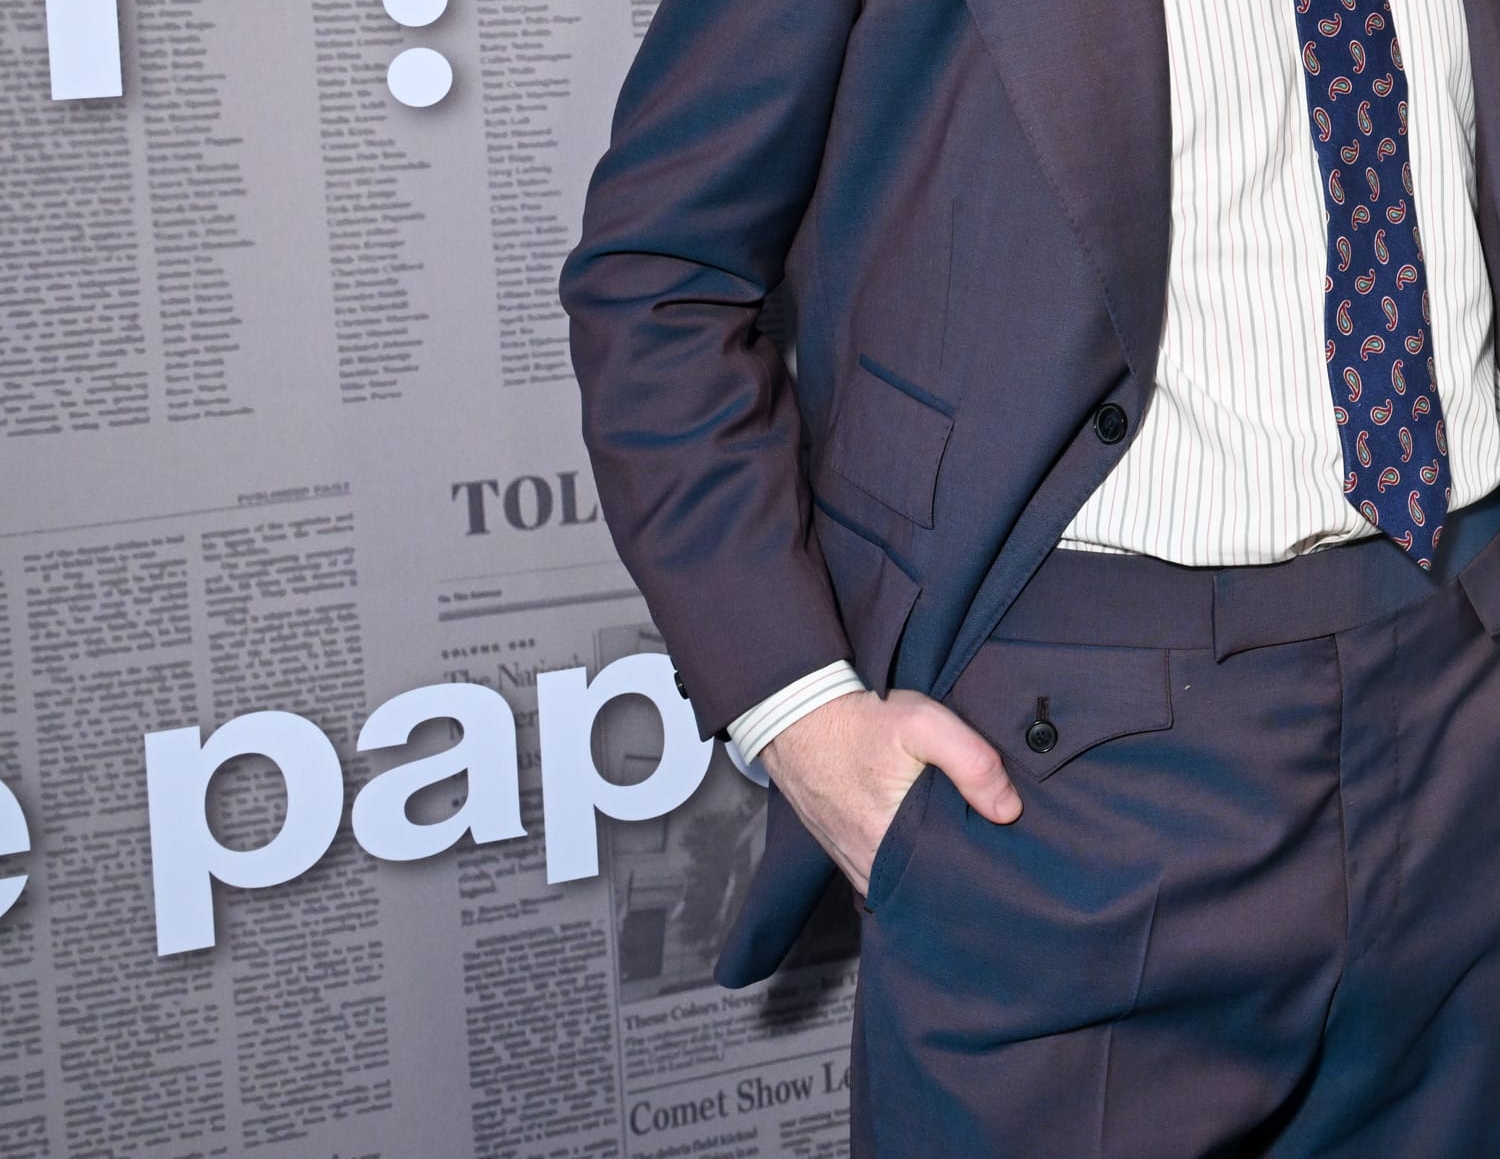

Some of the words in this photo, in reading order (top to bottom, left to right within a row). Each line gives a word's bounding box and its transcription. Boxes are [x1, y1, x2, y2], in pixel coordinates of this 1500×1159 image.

[145, 652, 770, 957] pap
[629, 1089, 729, 1137] Comet
[736, 1074, 814, 1114] Show
